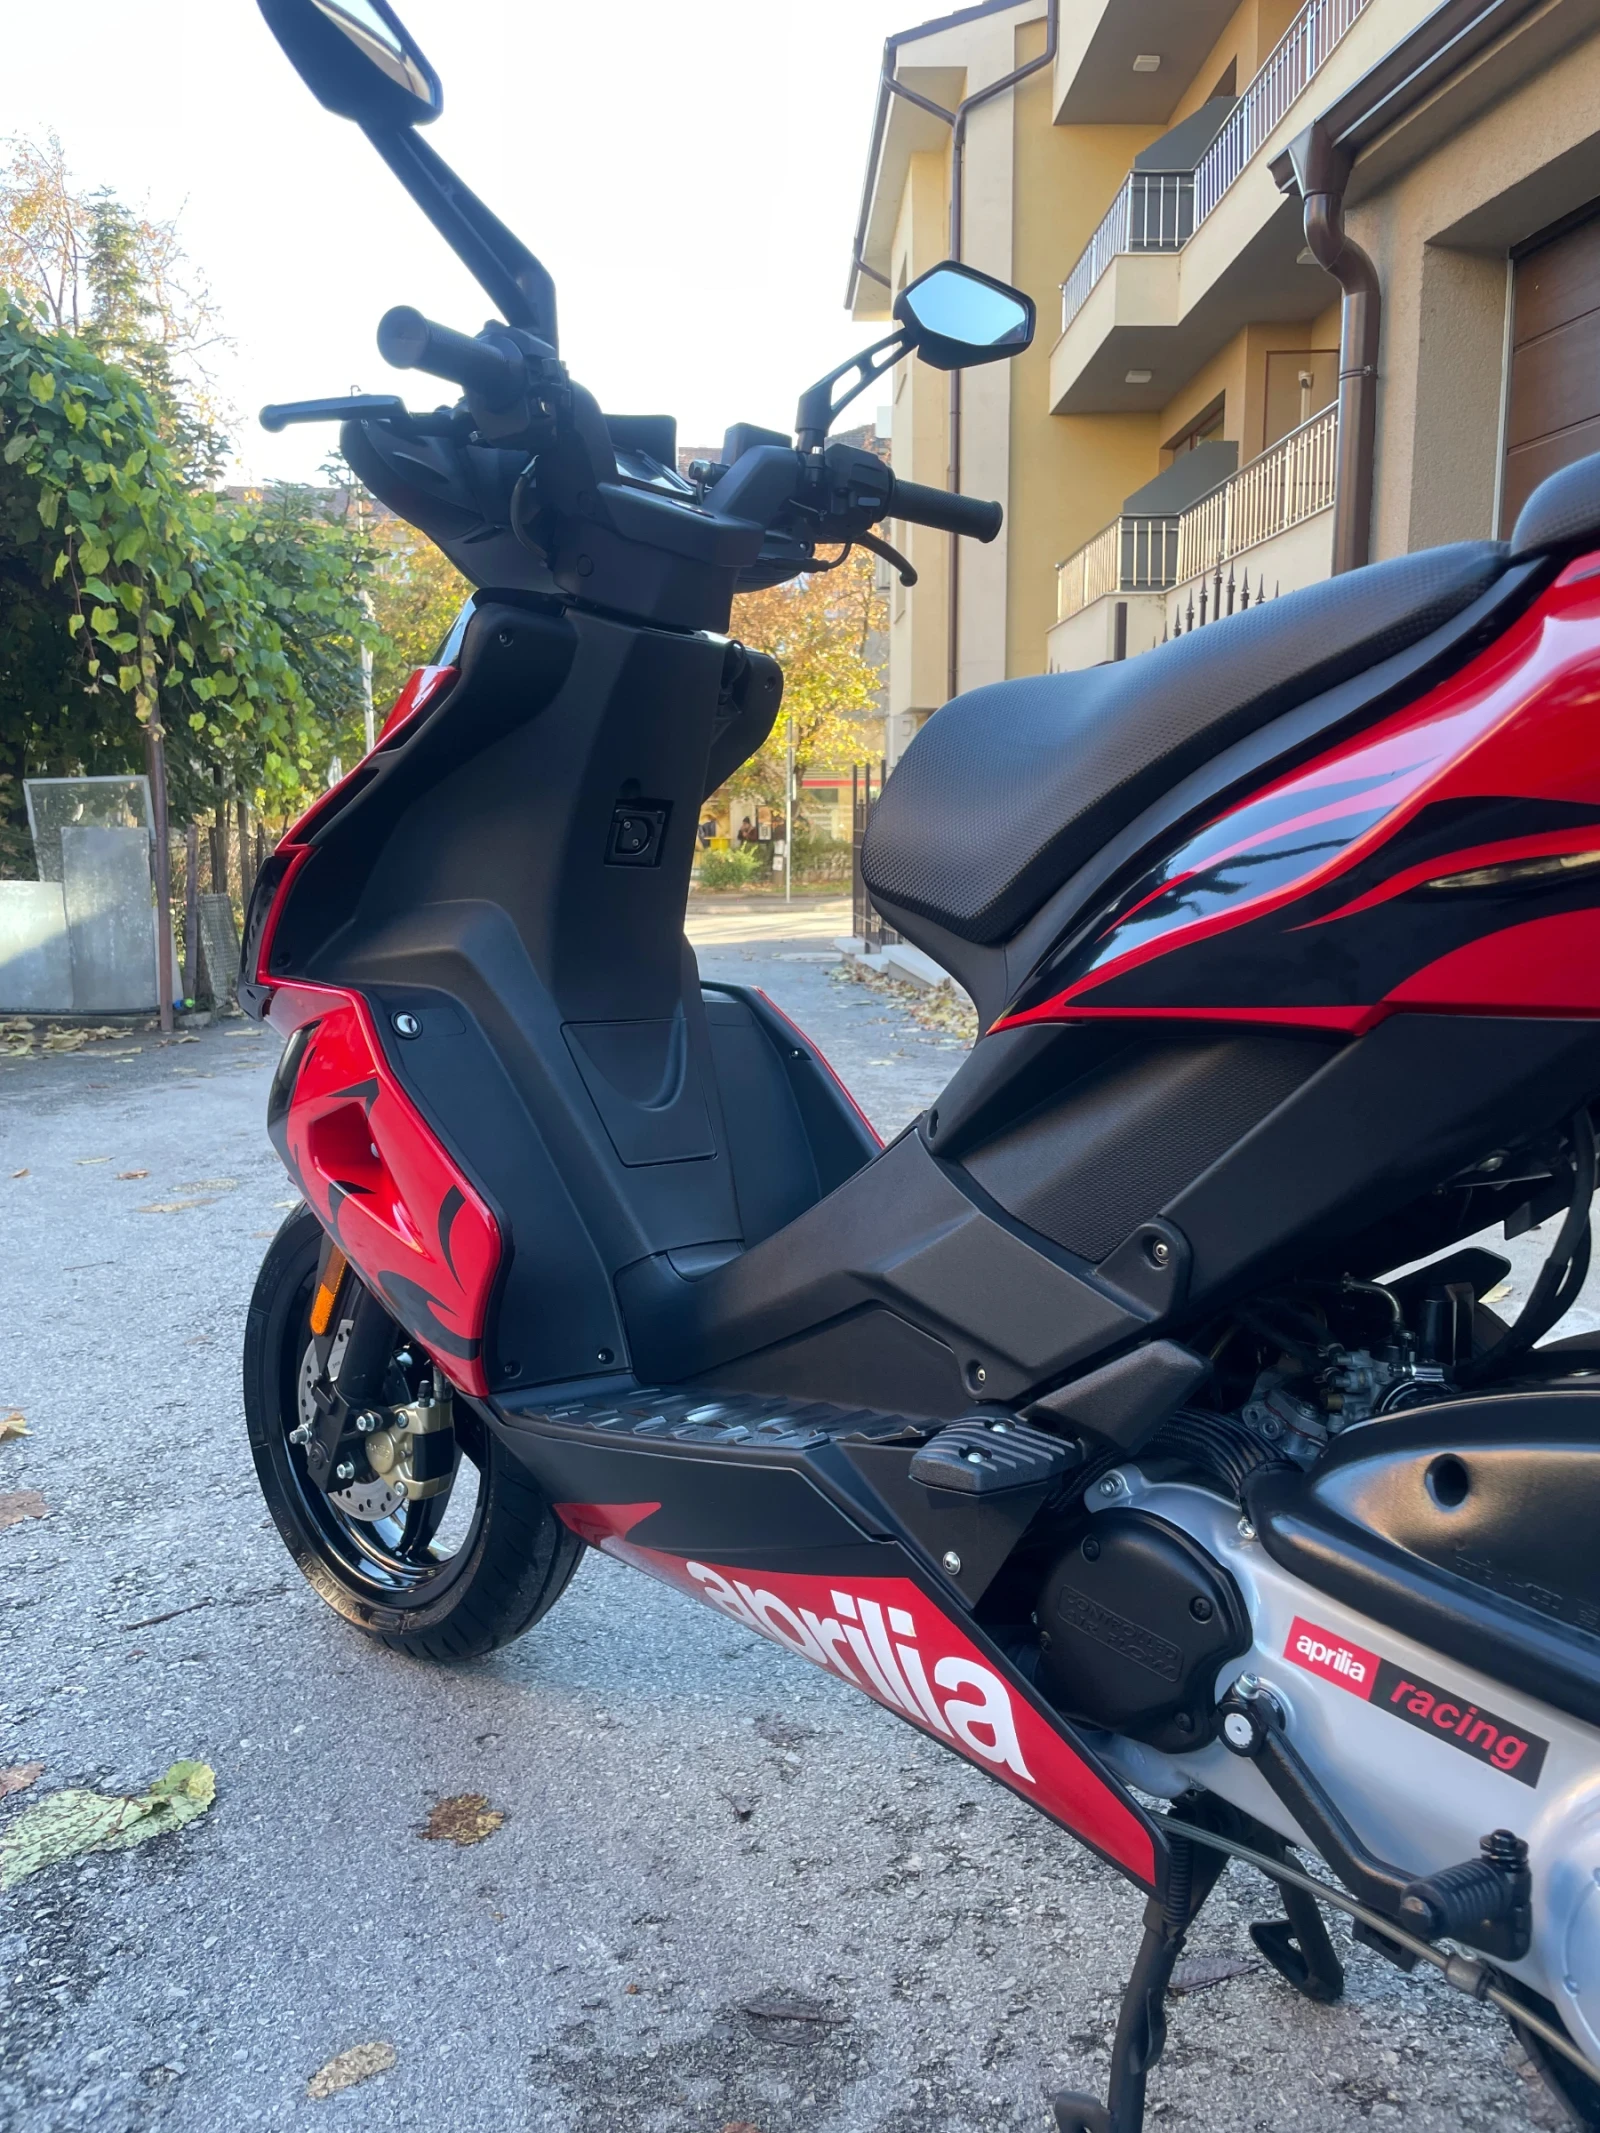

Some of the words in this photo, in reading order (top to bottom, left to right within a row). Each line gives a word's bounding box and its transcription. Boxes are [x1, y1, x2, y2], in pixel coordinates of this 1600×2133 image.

[685, 1561, 1036, 1784] aprilia
[1063, 1607, 1099, 1635] AIR
[1107, 1631, 1177, 1674] FLOW
[1066, 1592, 1179, 1661] CONTROLLED
[1296, 1634, 1366, 1682] aprilia
[1390, 1680, 1529, 1770] racing
